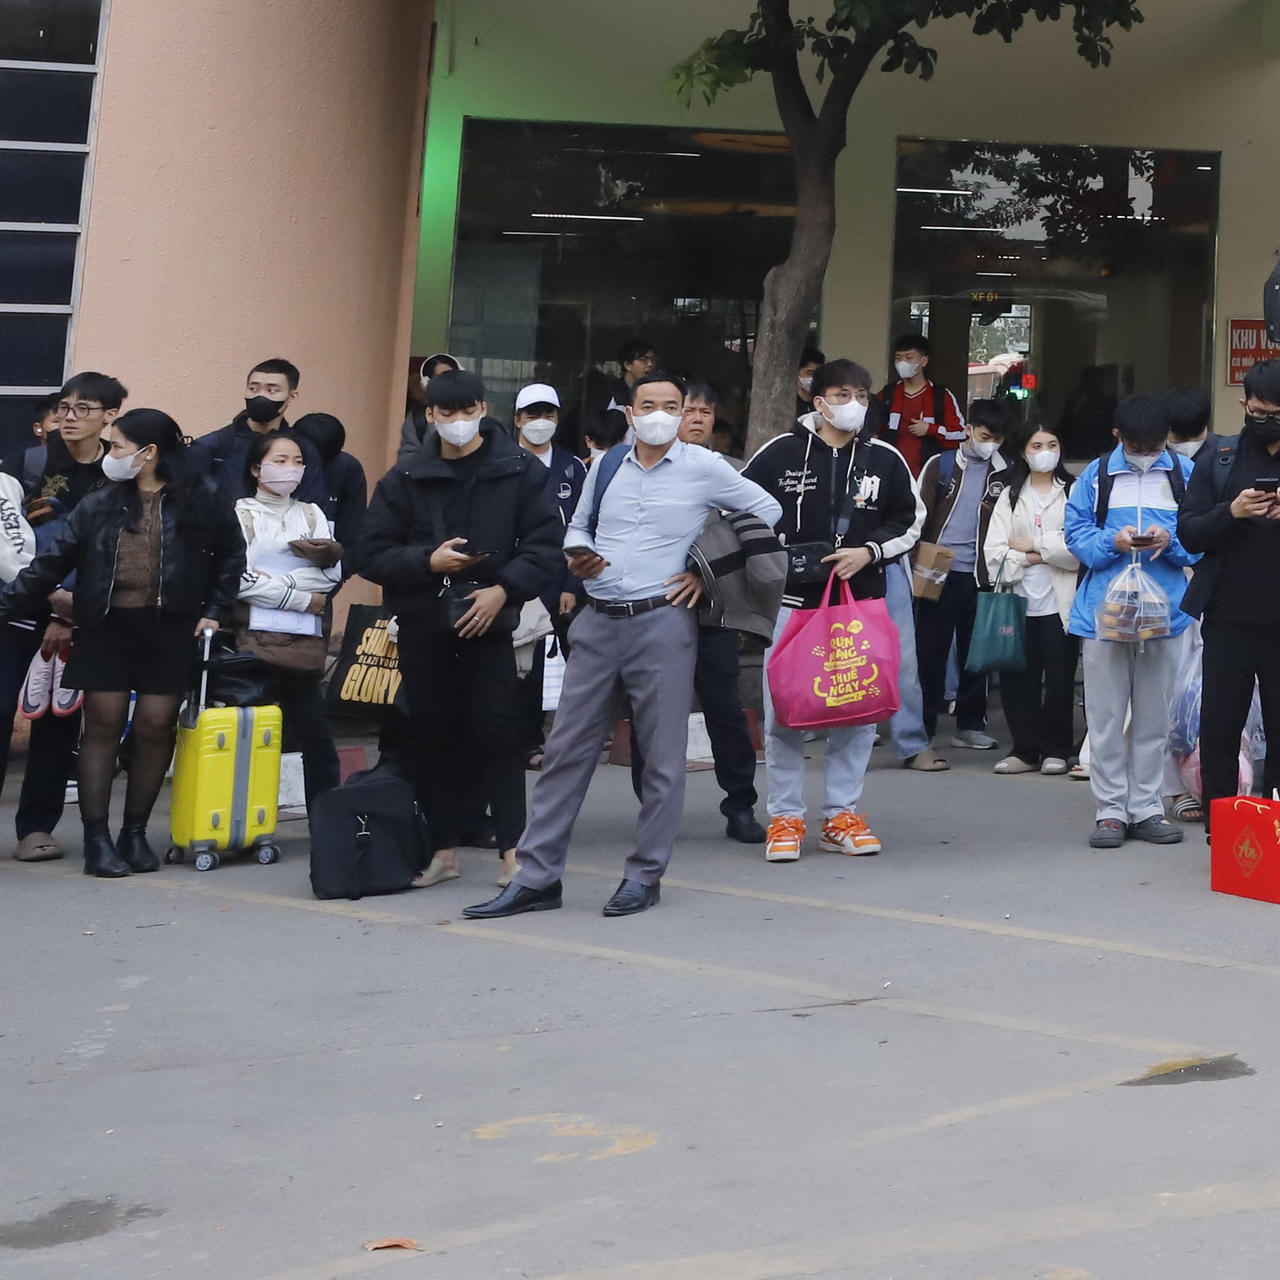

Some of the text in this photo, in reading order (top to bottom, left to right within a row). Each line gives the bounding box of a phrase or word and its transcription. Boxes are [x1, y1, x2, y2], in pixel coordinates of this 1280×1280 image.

[1232, 329, 1257, 349] KHU
[340, 663, 403, 705] GLORY
[830, 666, 858, 685] THUÊ
[829, 681, 859, 697] NGAY
